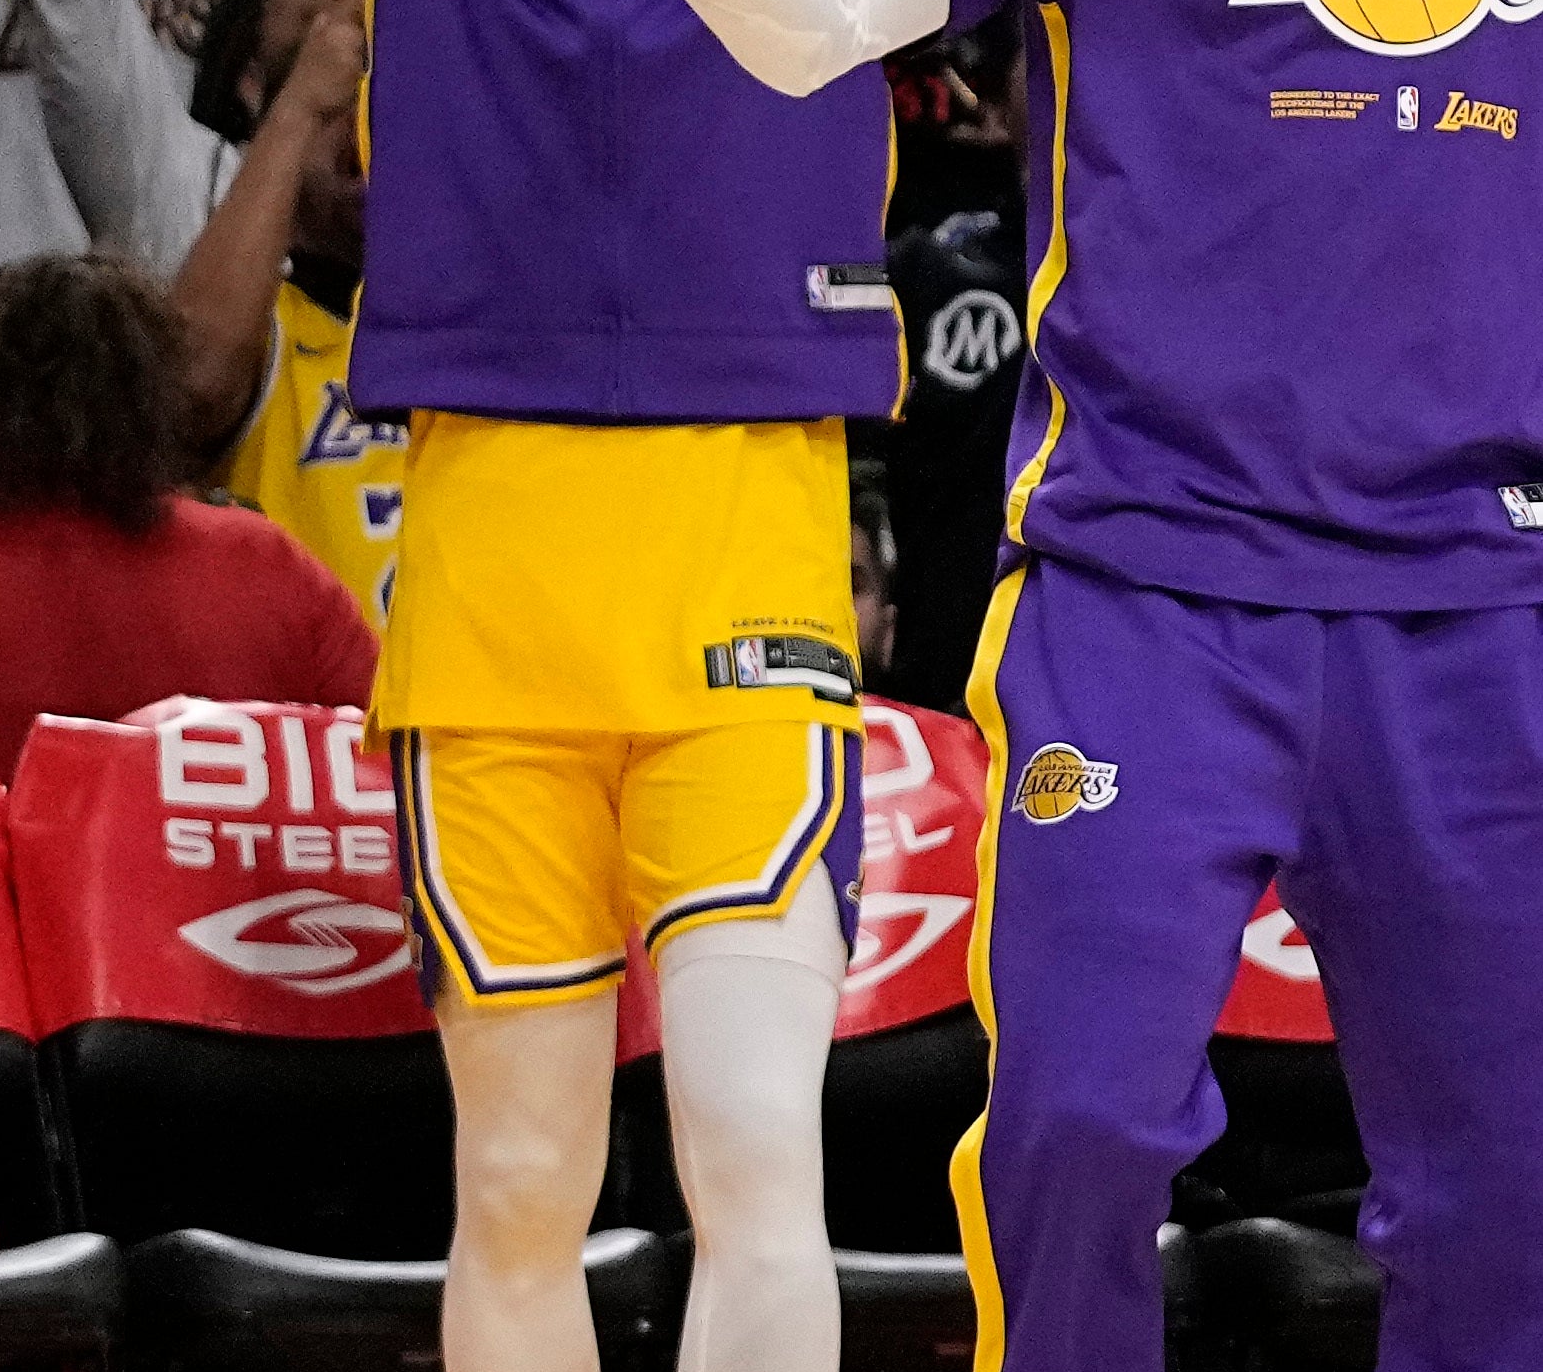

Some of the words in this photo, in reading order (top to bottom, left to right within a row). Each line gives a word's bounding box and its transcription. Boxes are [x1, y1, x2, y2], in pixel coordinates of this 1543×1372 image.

[1434, 90, 1519, 141] LAKERS
[1014, 766, 1114, 805] LAKERS
[165, 819, 391, 873] STEE
